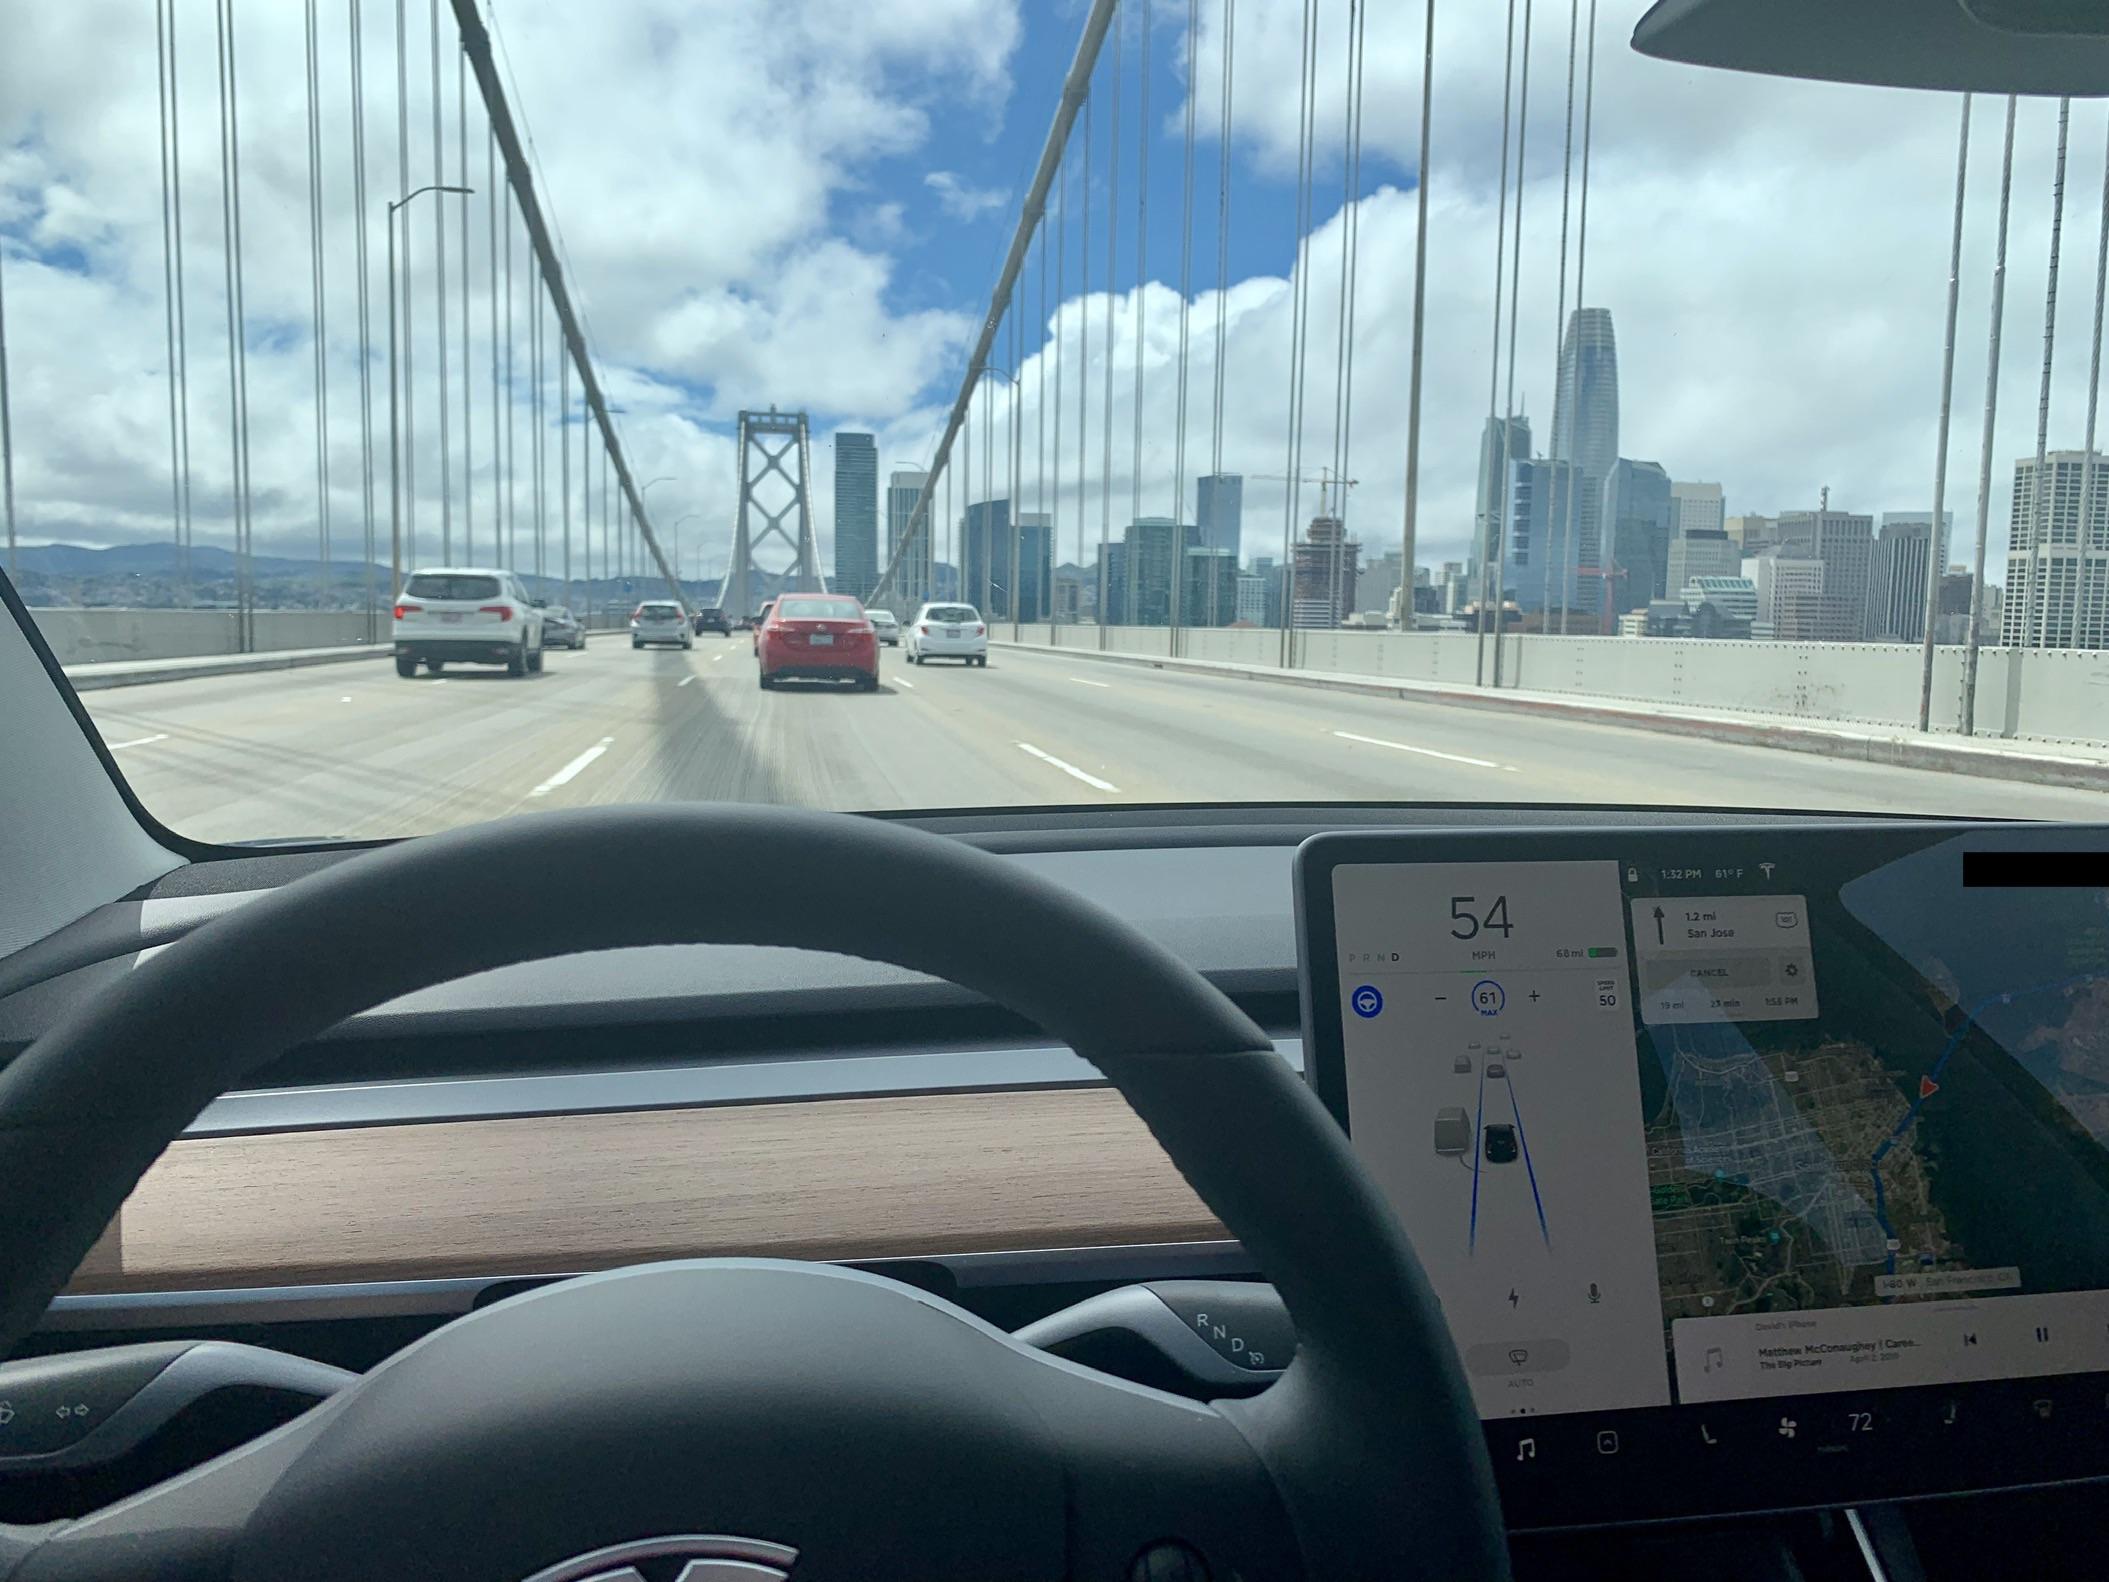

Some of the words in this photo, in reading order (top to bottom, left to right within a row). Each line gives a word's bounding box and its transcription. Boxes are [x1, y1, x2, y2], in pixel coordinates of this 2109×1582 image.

[1661, 869, 1682, 880] 1:32
[1685, 869, 1702, 879] PM
[1451, 896, 1513, 940] 54
[1685, 913, 1700, 922] 1.2
[1703, 911, 1716, 921] mi
[1687, 928, 1707, 938] San
[1710, 928, 1735, 937] Jose
[1391, 952, 1400, 962] D
[1472, 951, 1496, 960] MPH
[1690, 968, 1728, 977] CANCEL
[1480, 992, 1496, 1005] 61
[1599, 995, 1616, 1006] 50
[1481, 1009, 1498, 1017] MAX
[1197, 1313, 1209, 1327] R
[1213, 1325, 1226, 1339] N
[1231, 1337, 1245, 1352] D
[1758, 1347, 1802, 1357] Matthew
[1804, 1342, 1876, 1354] McConaughey
[1760, 1361, 1776, 1369] The
[1848, 1412, 1873, 1432] 72
